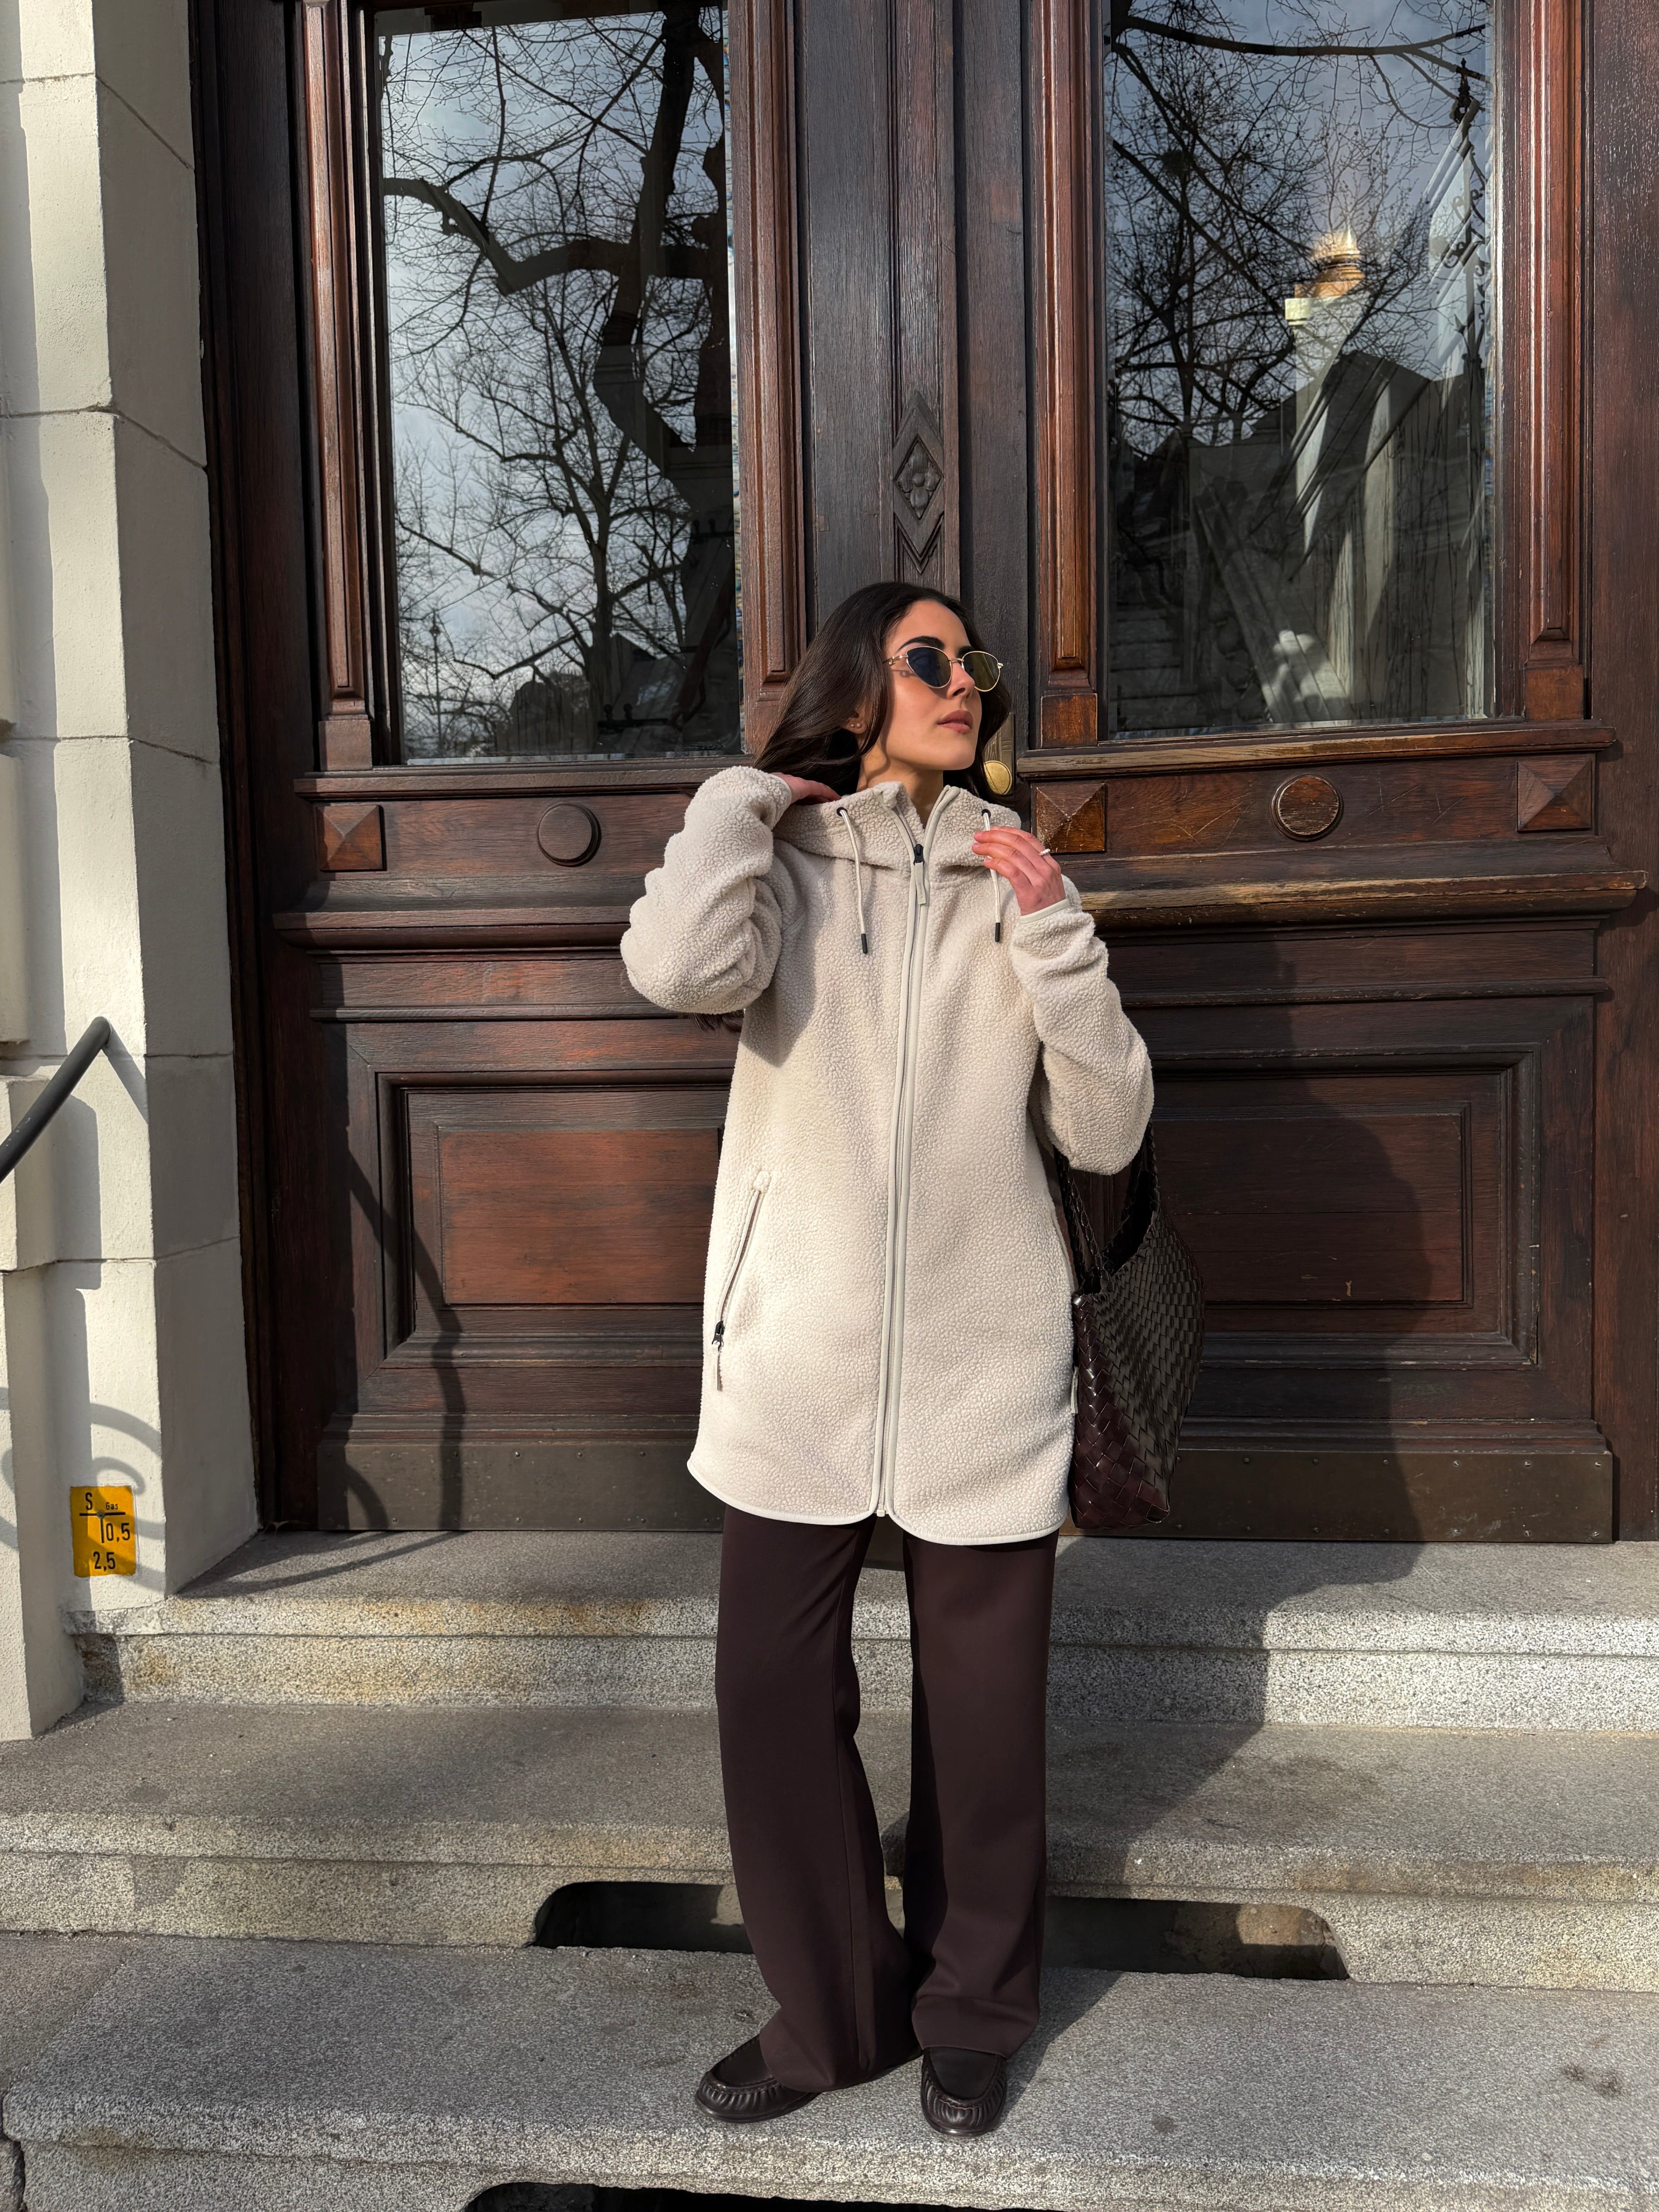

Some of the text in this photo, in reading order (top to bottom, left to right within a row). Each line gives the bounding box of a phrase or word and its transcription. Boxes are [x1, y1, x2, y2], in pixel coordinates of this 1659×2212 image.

[85, 1492, 93, 1510] S
[106, 1523, 131, 1542] 0,5
[93, 1551, 116, 1572] 2,5
